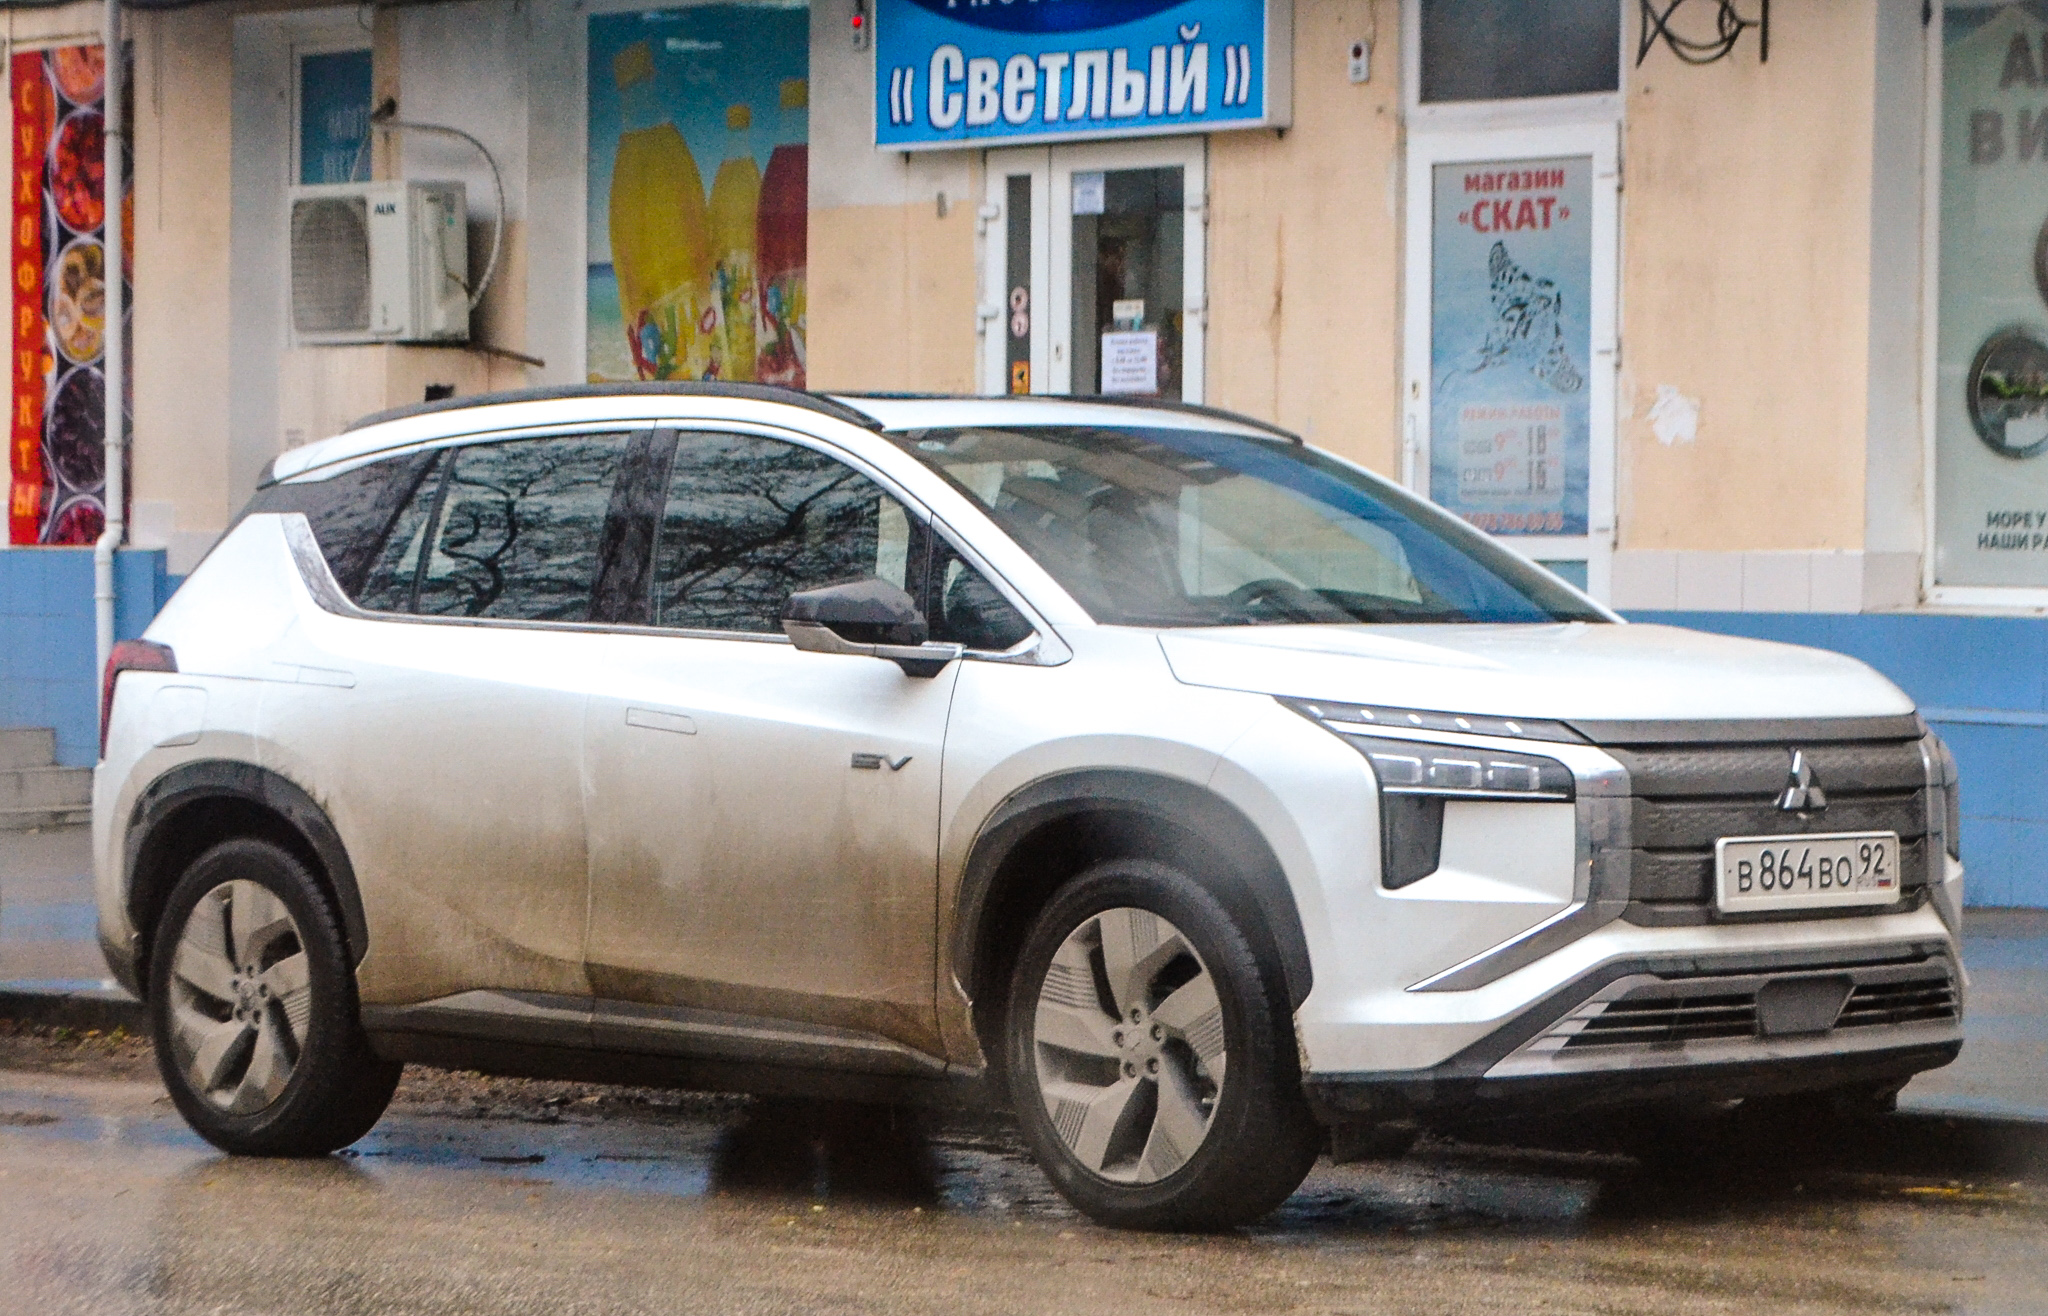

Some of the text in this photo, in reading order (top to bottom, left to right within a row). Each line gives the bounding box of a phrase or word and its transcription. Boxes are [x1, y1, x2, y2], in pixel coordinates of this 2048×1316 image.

[1464, 169, 1564, 194] магазин
[1458, 196, 1570, 232] «СКАТ»
[14, 79, 37, 516] СУХОФРУКТЫ
[1987, 510, 2032, 529] МОРЕ
[1978, 532, 2029, 551] НАШИ
[1859, 843, 1885, 875] 92
